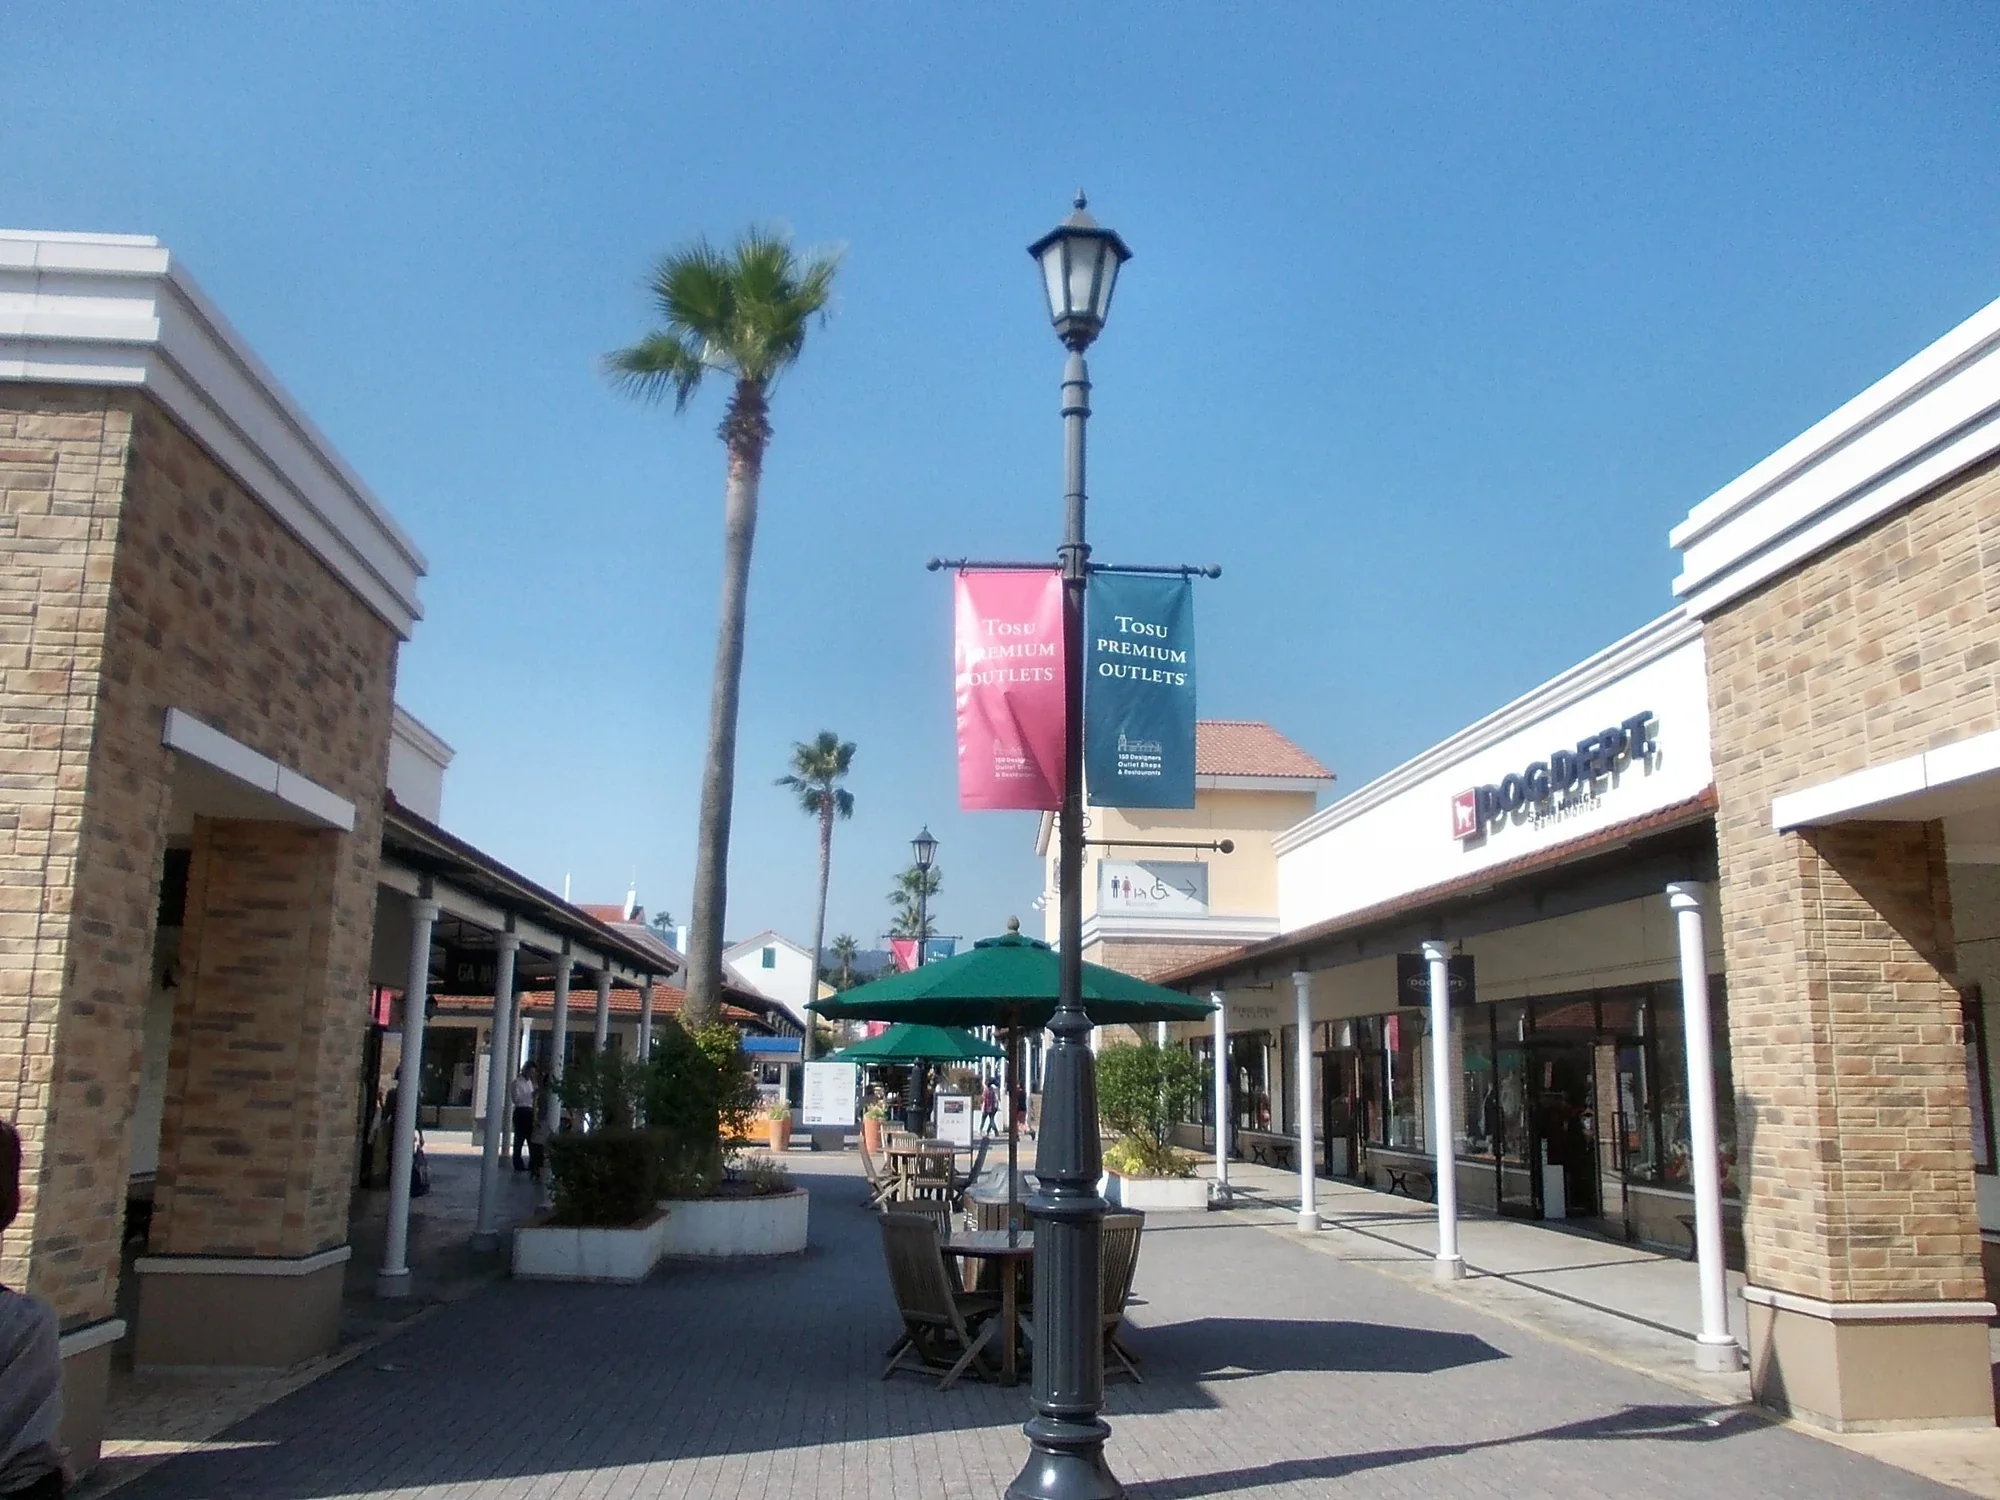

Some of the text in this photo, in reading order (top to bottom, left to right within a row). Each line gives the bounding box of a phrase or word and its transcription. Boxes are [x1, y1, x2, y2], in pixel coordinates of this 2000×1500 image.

[1097, 638, 1187, 663] PREMIUM
[968, 666, 1054, 686] OUTLETS
[1099, 663, 1185, 686] OUTLETS
[1130, 754, 1161, 762] Designers
